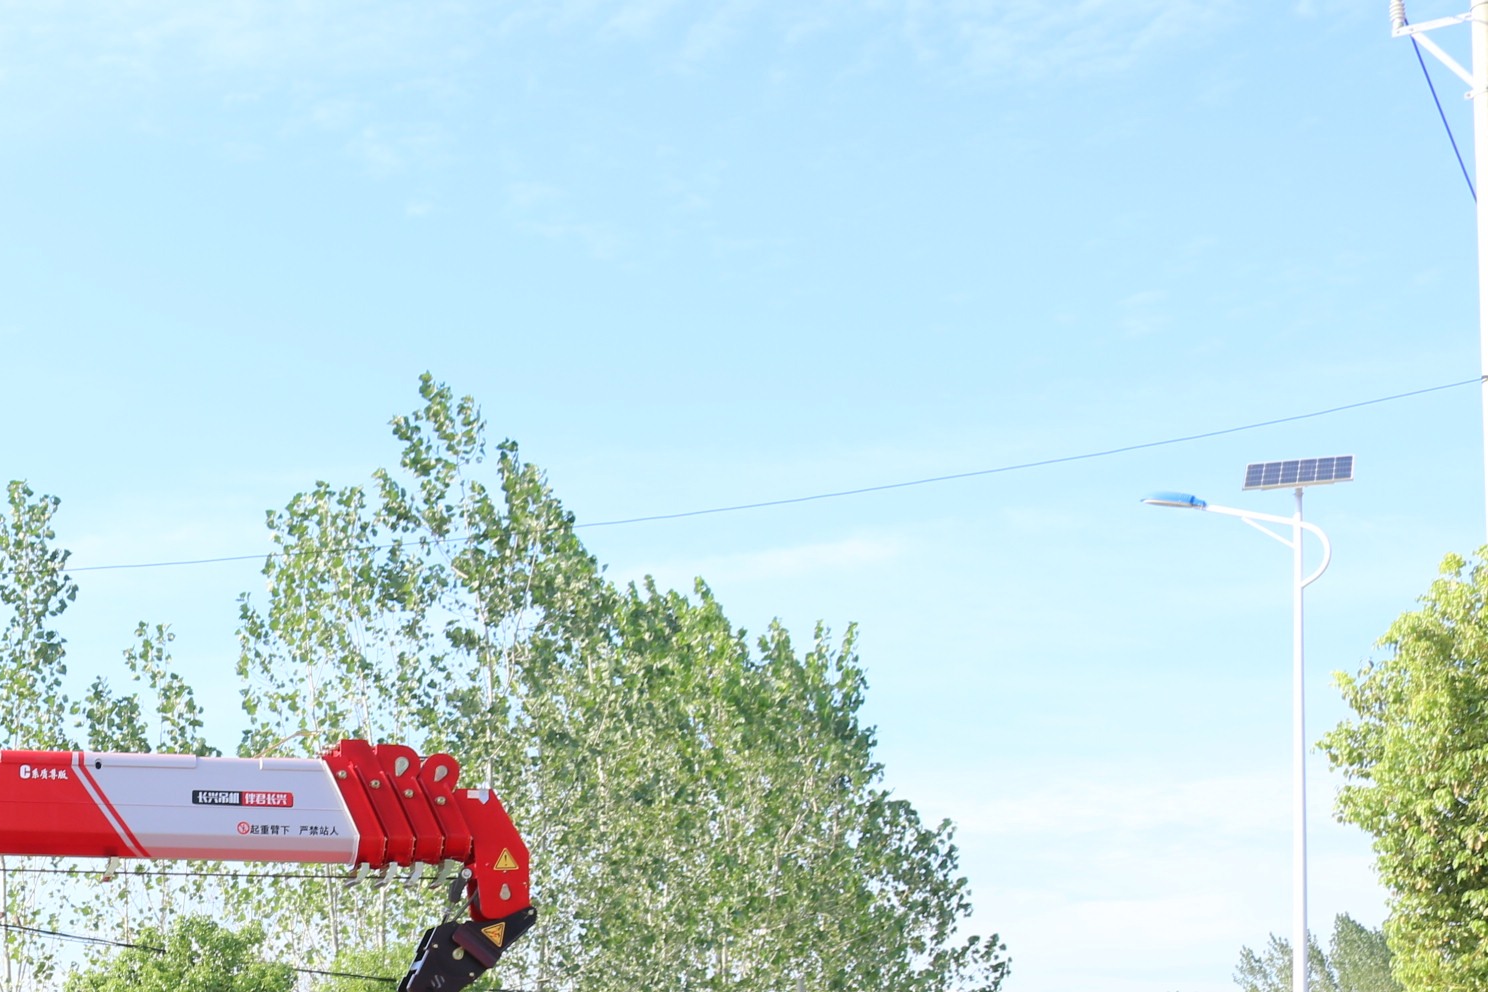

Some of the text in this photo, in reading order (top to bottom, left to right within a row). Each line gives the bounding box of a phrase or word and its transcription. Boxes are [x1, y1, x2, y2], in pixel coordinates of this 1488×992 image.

[197, 791, 287, 806] 长兴吊机 伴君长兴
[250, 824, 340, 836] 起重臂下 严禁站人
